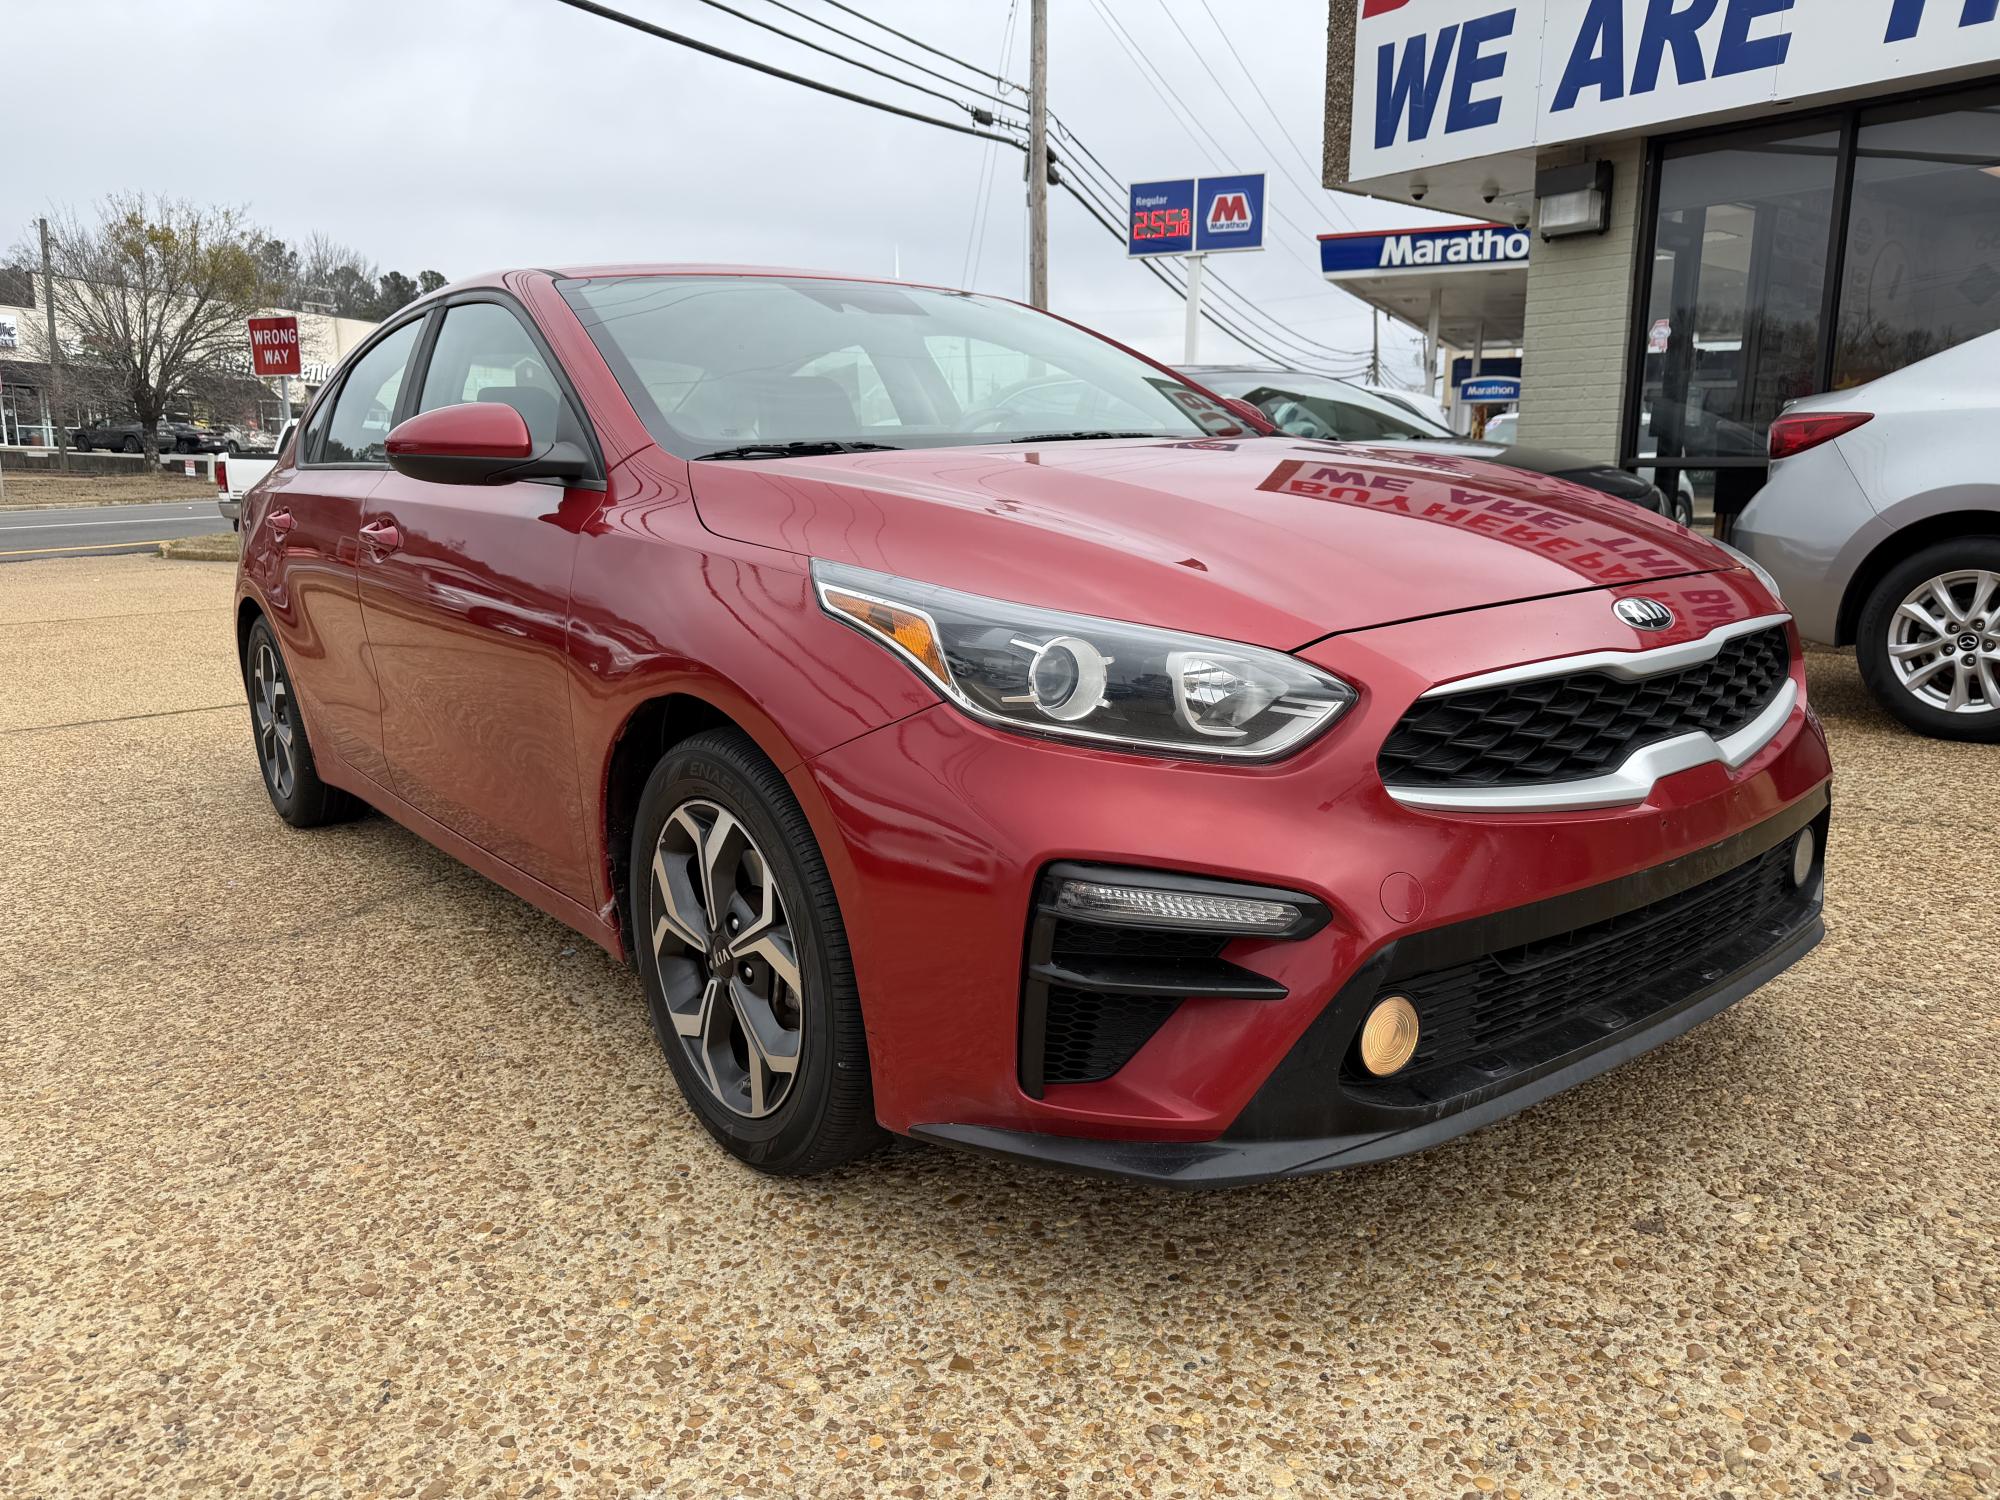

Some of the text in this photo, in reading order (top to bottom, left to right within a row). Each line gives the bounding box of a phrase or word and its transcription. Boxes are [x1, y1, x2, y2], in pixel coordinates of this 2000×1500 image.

[1374, 0, 1795, 149] WE ARE
[1136, 196, 1168, 207] Regular
[1210, 222, 1249, 231] Marathon
[1379, 230, 1530, 267] Maratho
[253, 328, 297, 345] WRONG
[263, 349, 289, 365] WAY
[1467, 386, 1515, 396] Marathon
[1617, 597, 1670, 624] KIA
[715, 948, 731, 968] KIA
